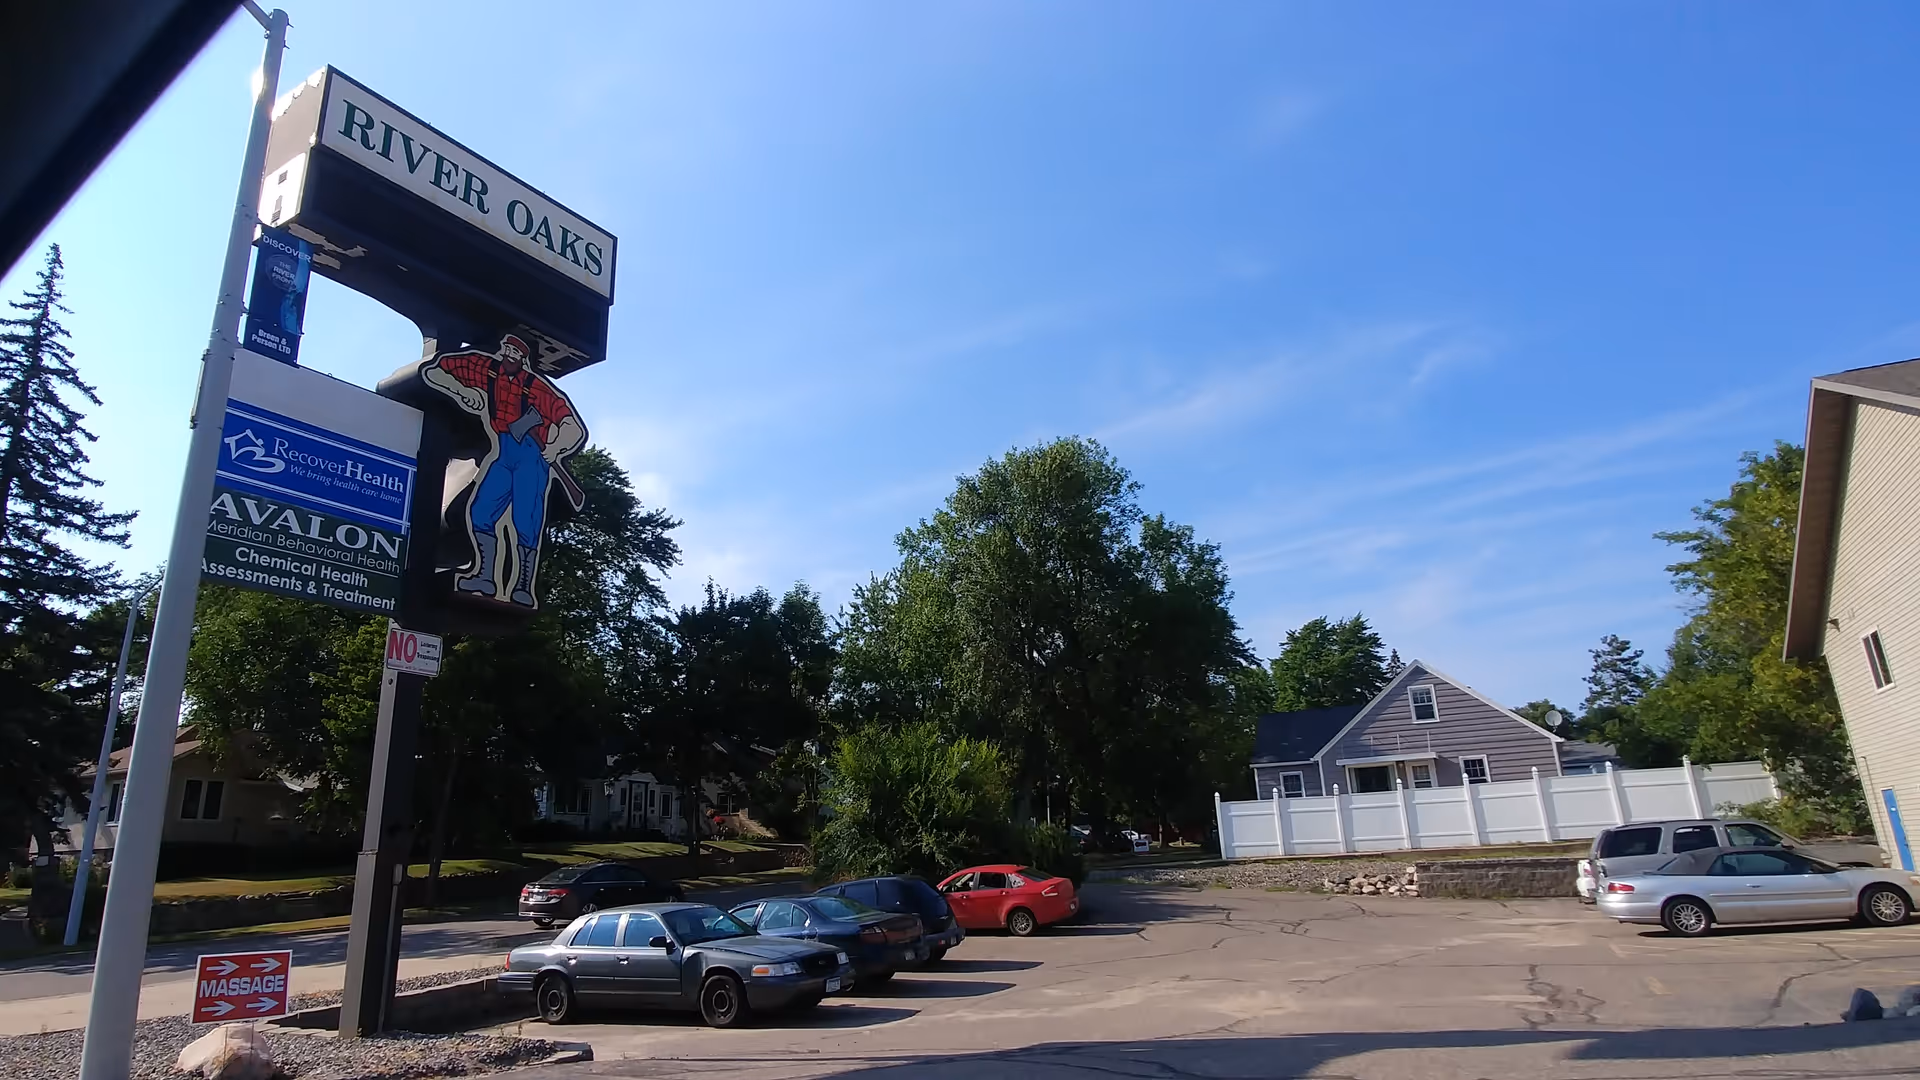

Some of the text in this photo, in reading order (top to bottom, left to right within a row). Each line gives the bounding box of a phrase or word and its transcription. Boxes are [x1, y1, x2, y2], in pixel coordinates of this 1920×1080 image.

[338, 99, 603, 277] RIVER OAKS
[262, 235, 311, 263] DISCOVER
[273, 265, 295, 280] RIVER
[251, 333, 291, 355] Person LTD
[281, 337, 288, 346] &
[290, 464, 402, 504] We bring health care home
[209, 492, 403, 559] AVALON
[235, 547, 369, 588] Chemical Health
[277, 534, 354, 562] Behavioral
[357, 553, 400, 574] Health
[307, 581, 317, 595] &
[322, 583, 396, 611] Treatment
[388, 631, 418, 664] NO
[199, 974, 286, 999] MASSAGE
